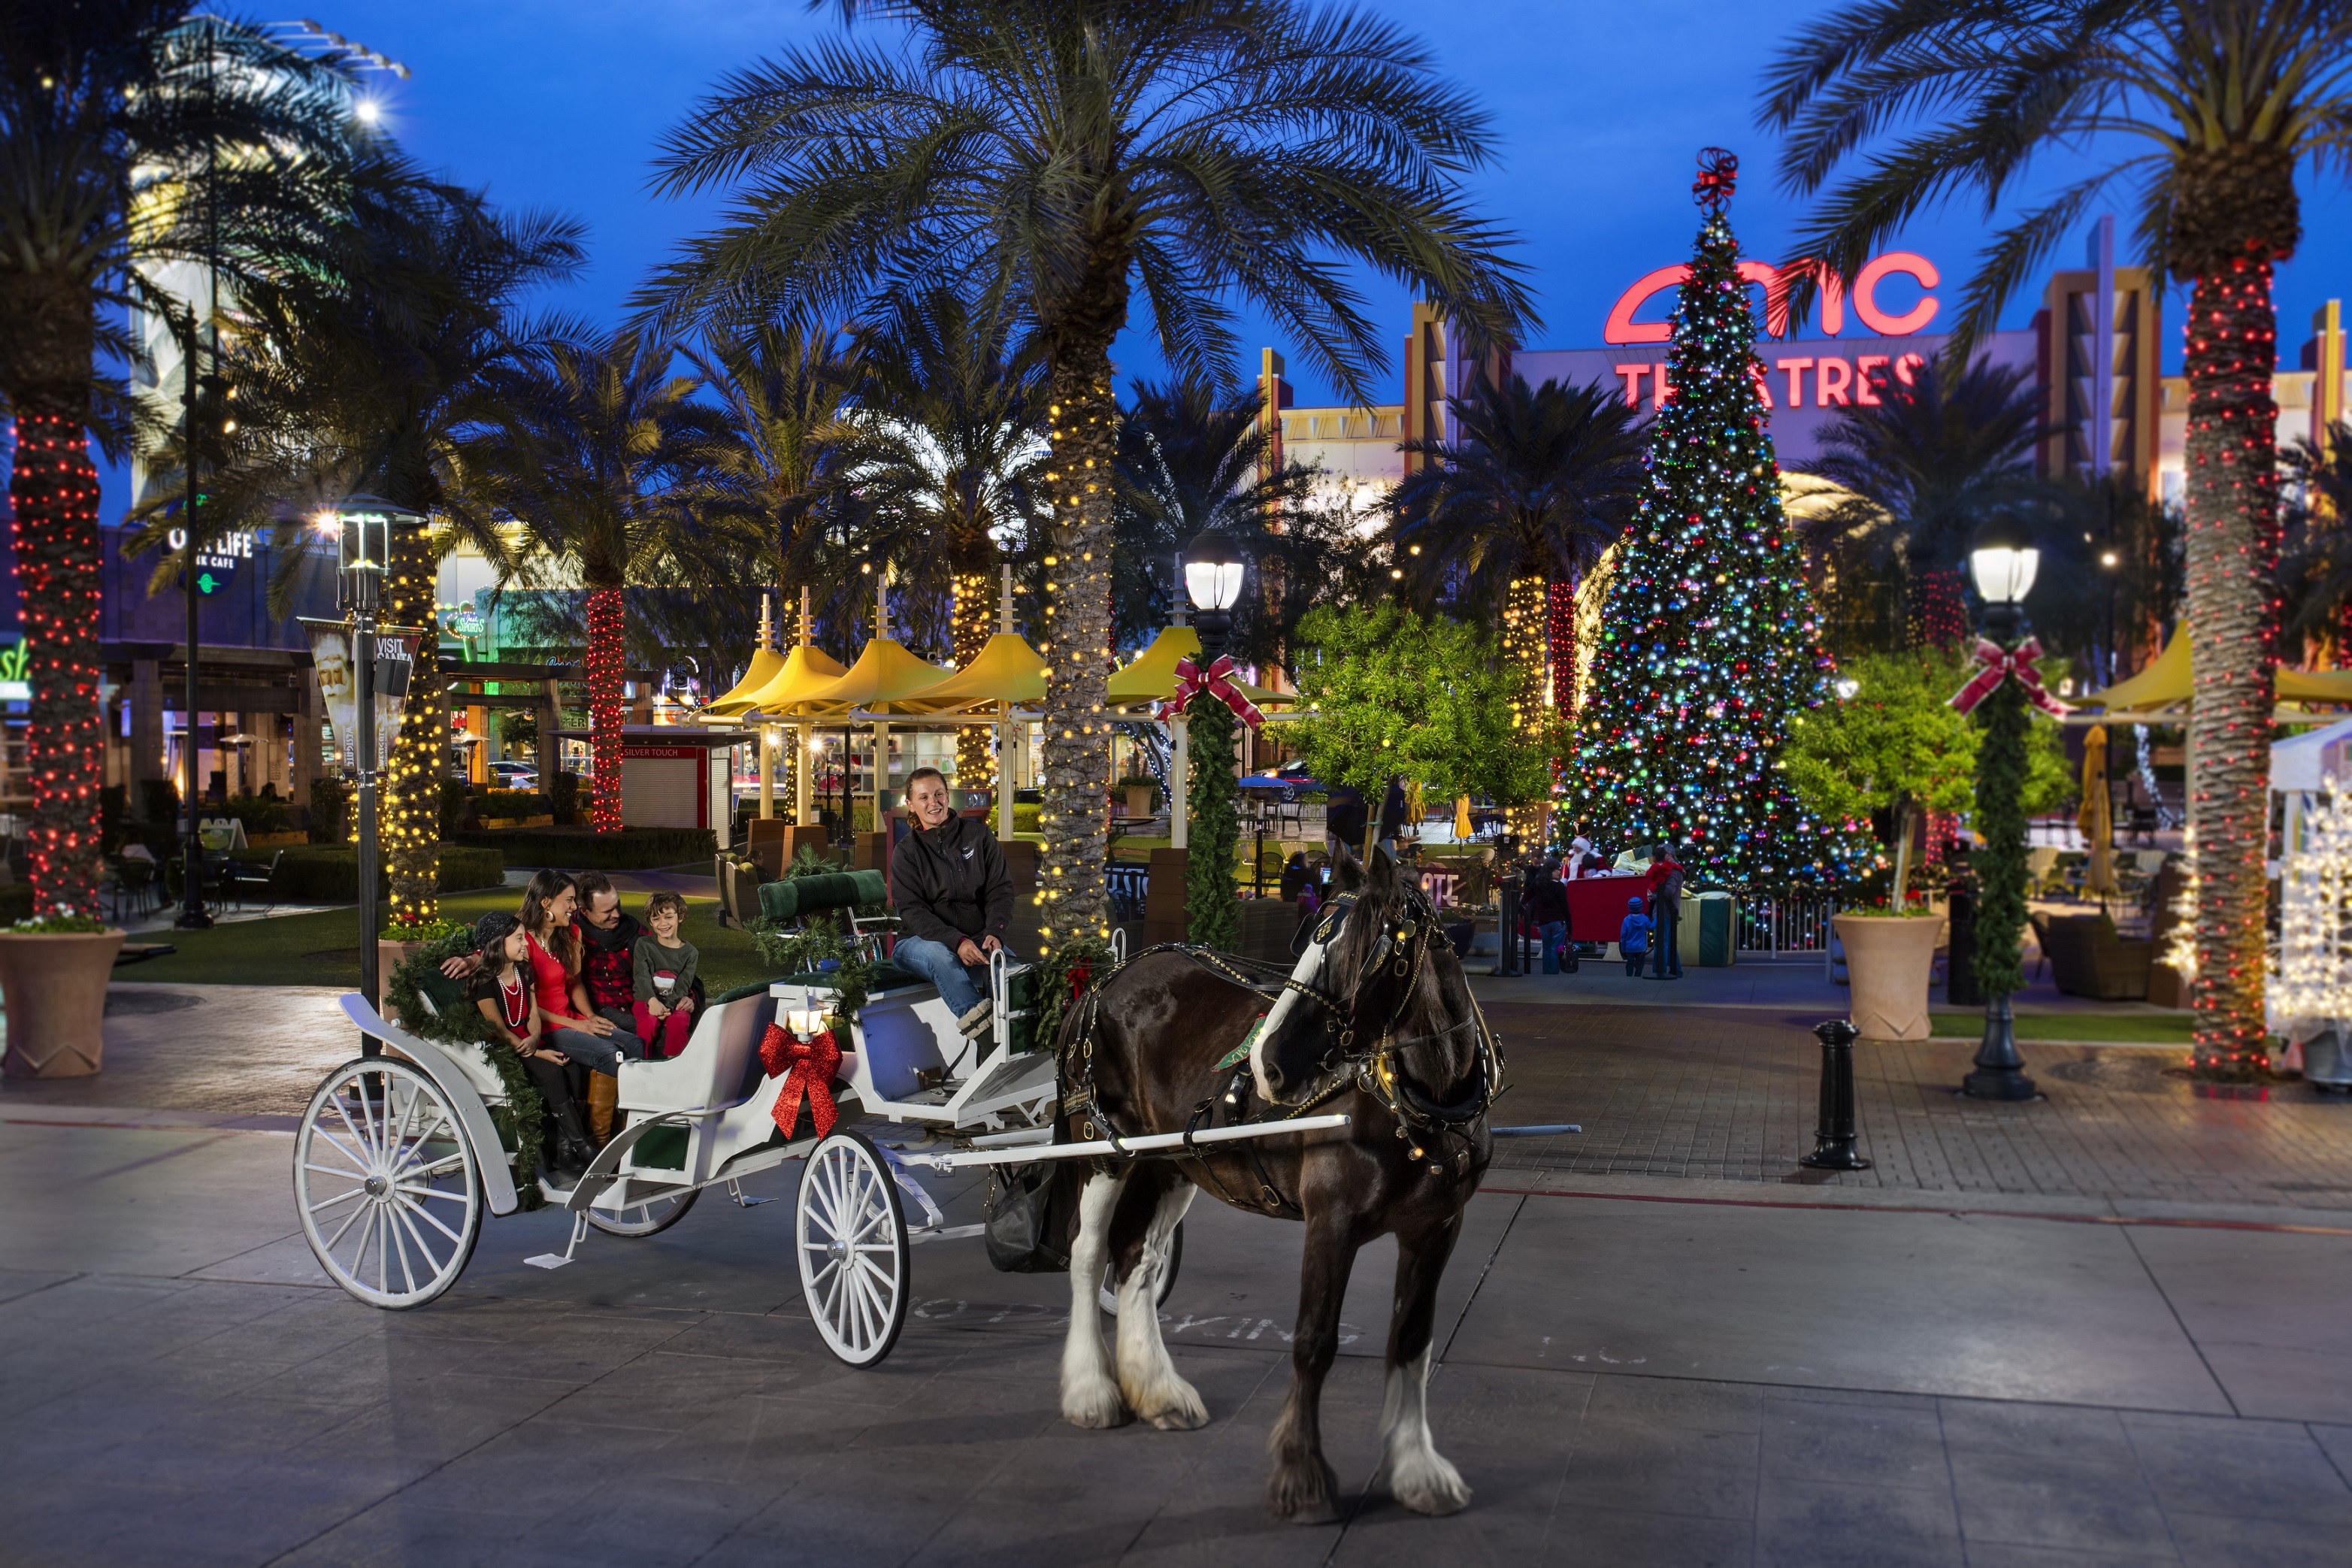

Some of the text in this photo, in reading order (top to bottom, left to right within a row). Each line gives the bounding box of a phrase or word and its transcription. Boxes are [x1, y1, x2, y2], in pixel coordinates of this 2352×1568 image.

[1615, 353, 1926, 413] THATRES
[217, 531, 253, 558] LIFE
[210, 557, 234, 569] CAFE
[377, 637, 404, 653] VISIT
[346, 725, 355, 767] WESTGATE
[624, 748, 678, 757] SILVER TOUCH
